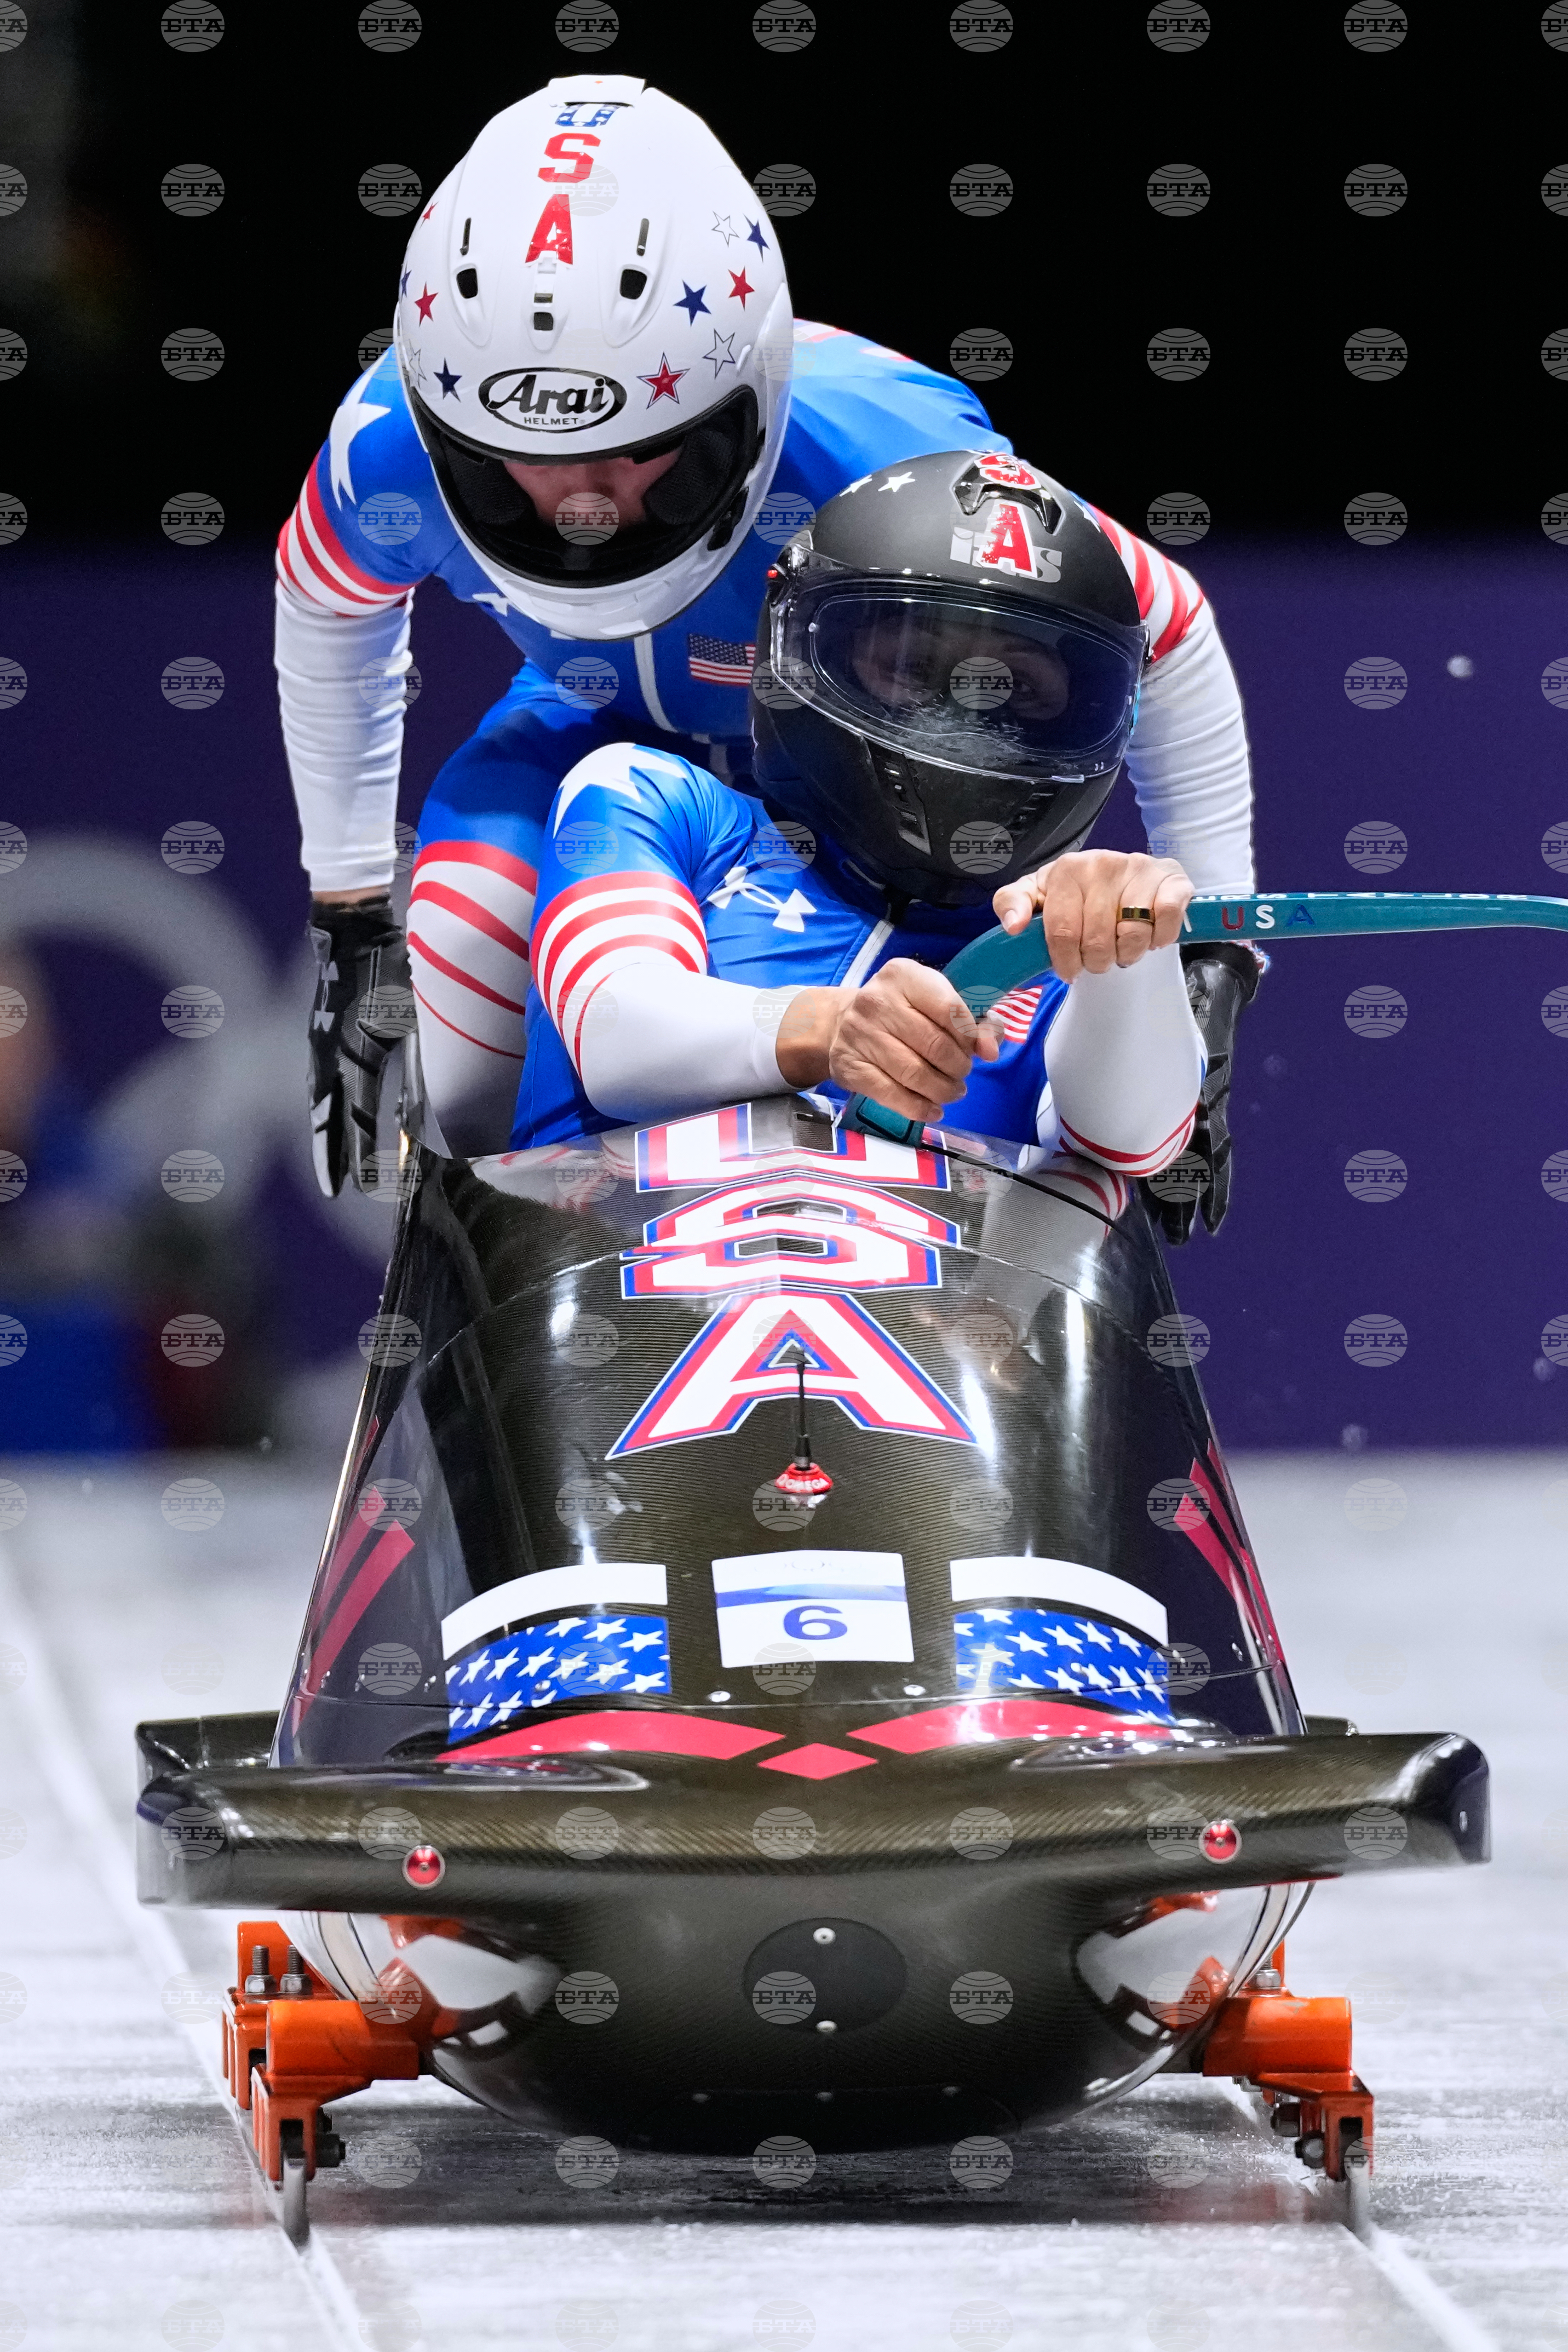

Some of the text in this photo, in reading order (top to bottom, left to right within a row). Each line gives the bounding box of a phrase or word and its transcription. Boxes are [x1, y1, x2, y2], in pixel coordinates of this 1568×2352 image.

[525, 103, 621, 265] USA
[487, 374, 609, 414] Arai
[524, 417, 578, 425] HELMET
[1221, 904, 1314, 930] USA
[605, 1103, 993, 1461] USA
[783, 1605, 848, 1640] 6
